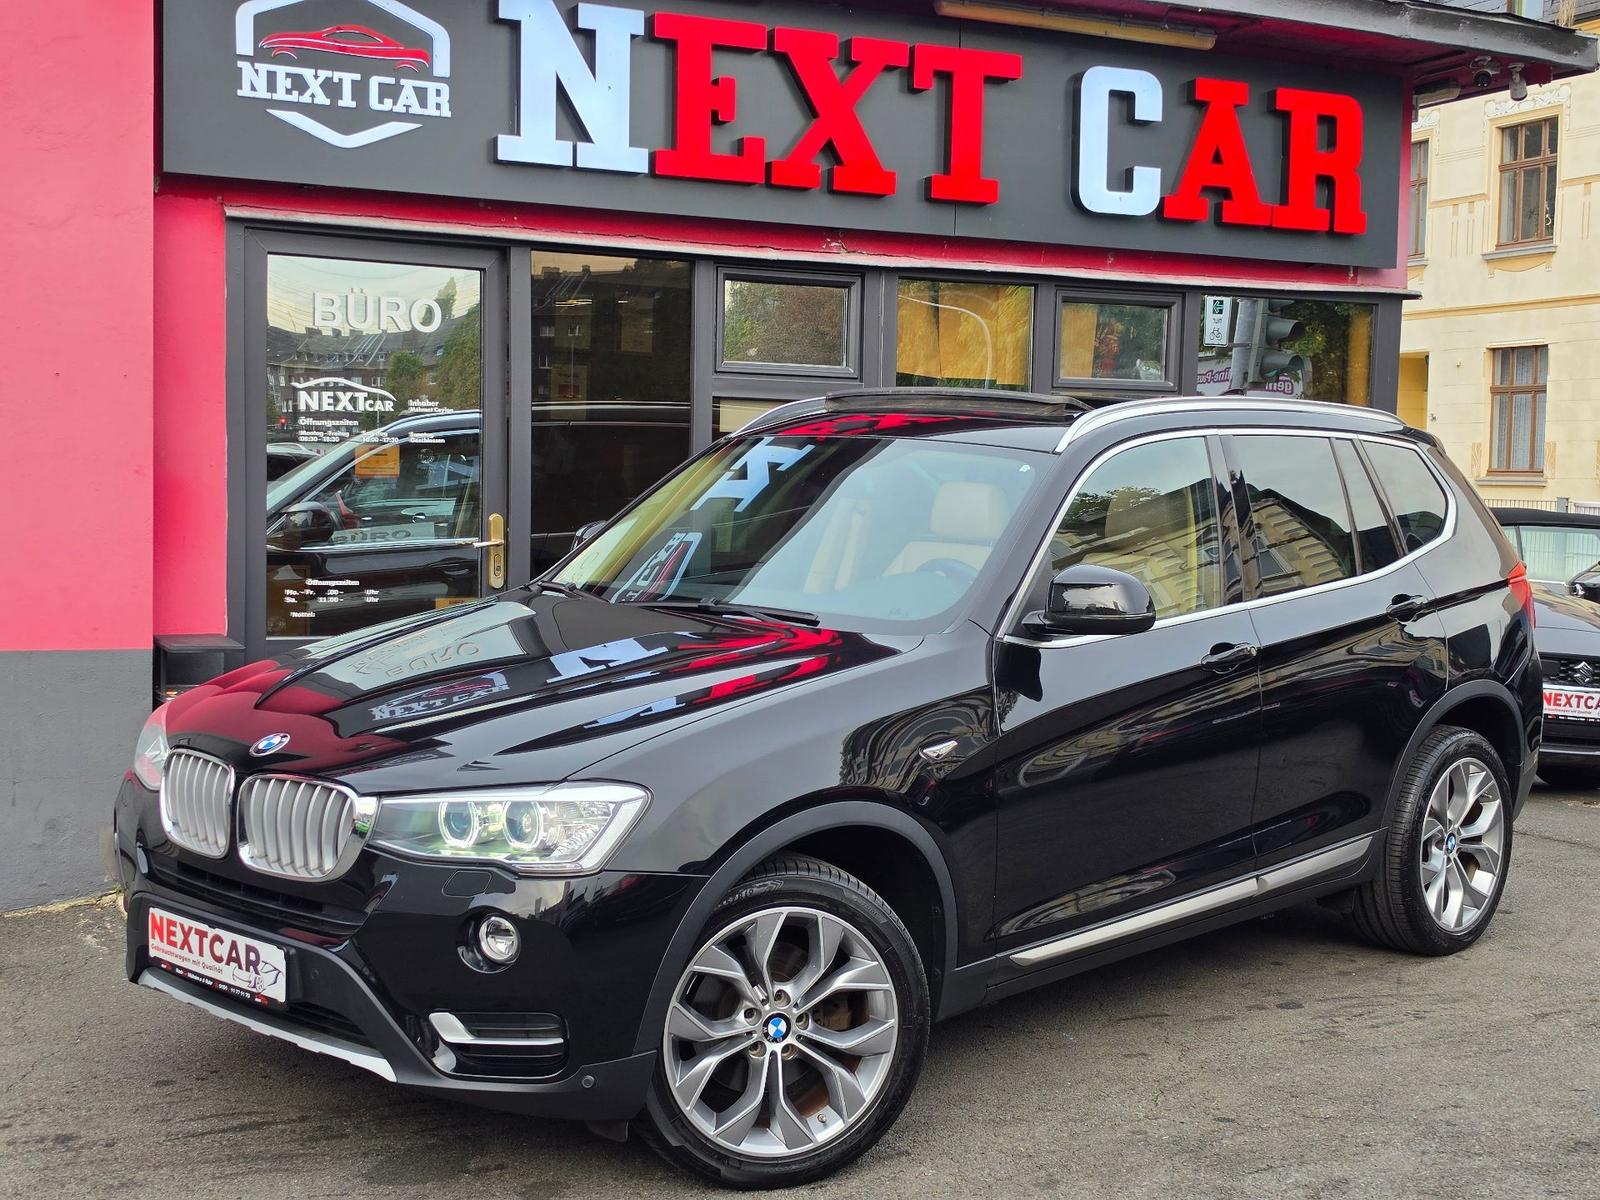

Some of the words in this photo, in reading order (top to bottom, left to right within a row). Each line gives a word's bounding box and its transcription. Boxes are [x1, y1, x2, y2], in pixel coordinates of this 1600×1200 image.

[236, 60, 361, 108] NEXT
[369, 75, 452, 118] CAR
[497, 0, 1022, 203] NEXT
[1079, 65, 1367, 235] CAR
[313, 288, 442, 333] BÜRO
[408, 399, 439, 407] Inhaber
[150, 912, 262, 976] NEXTCAR
